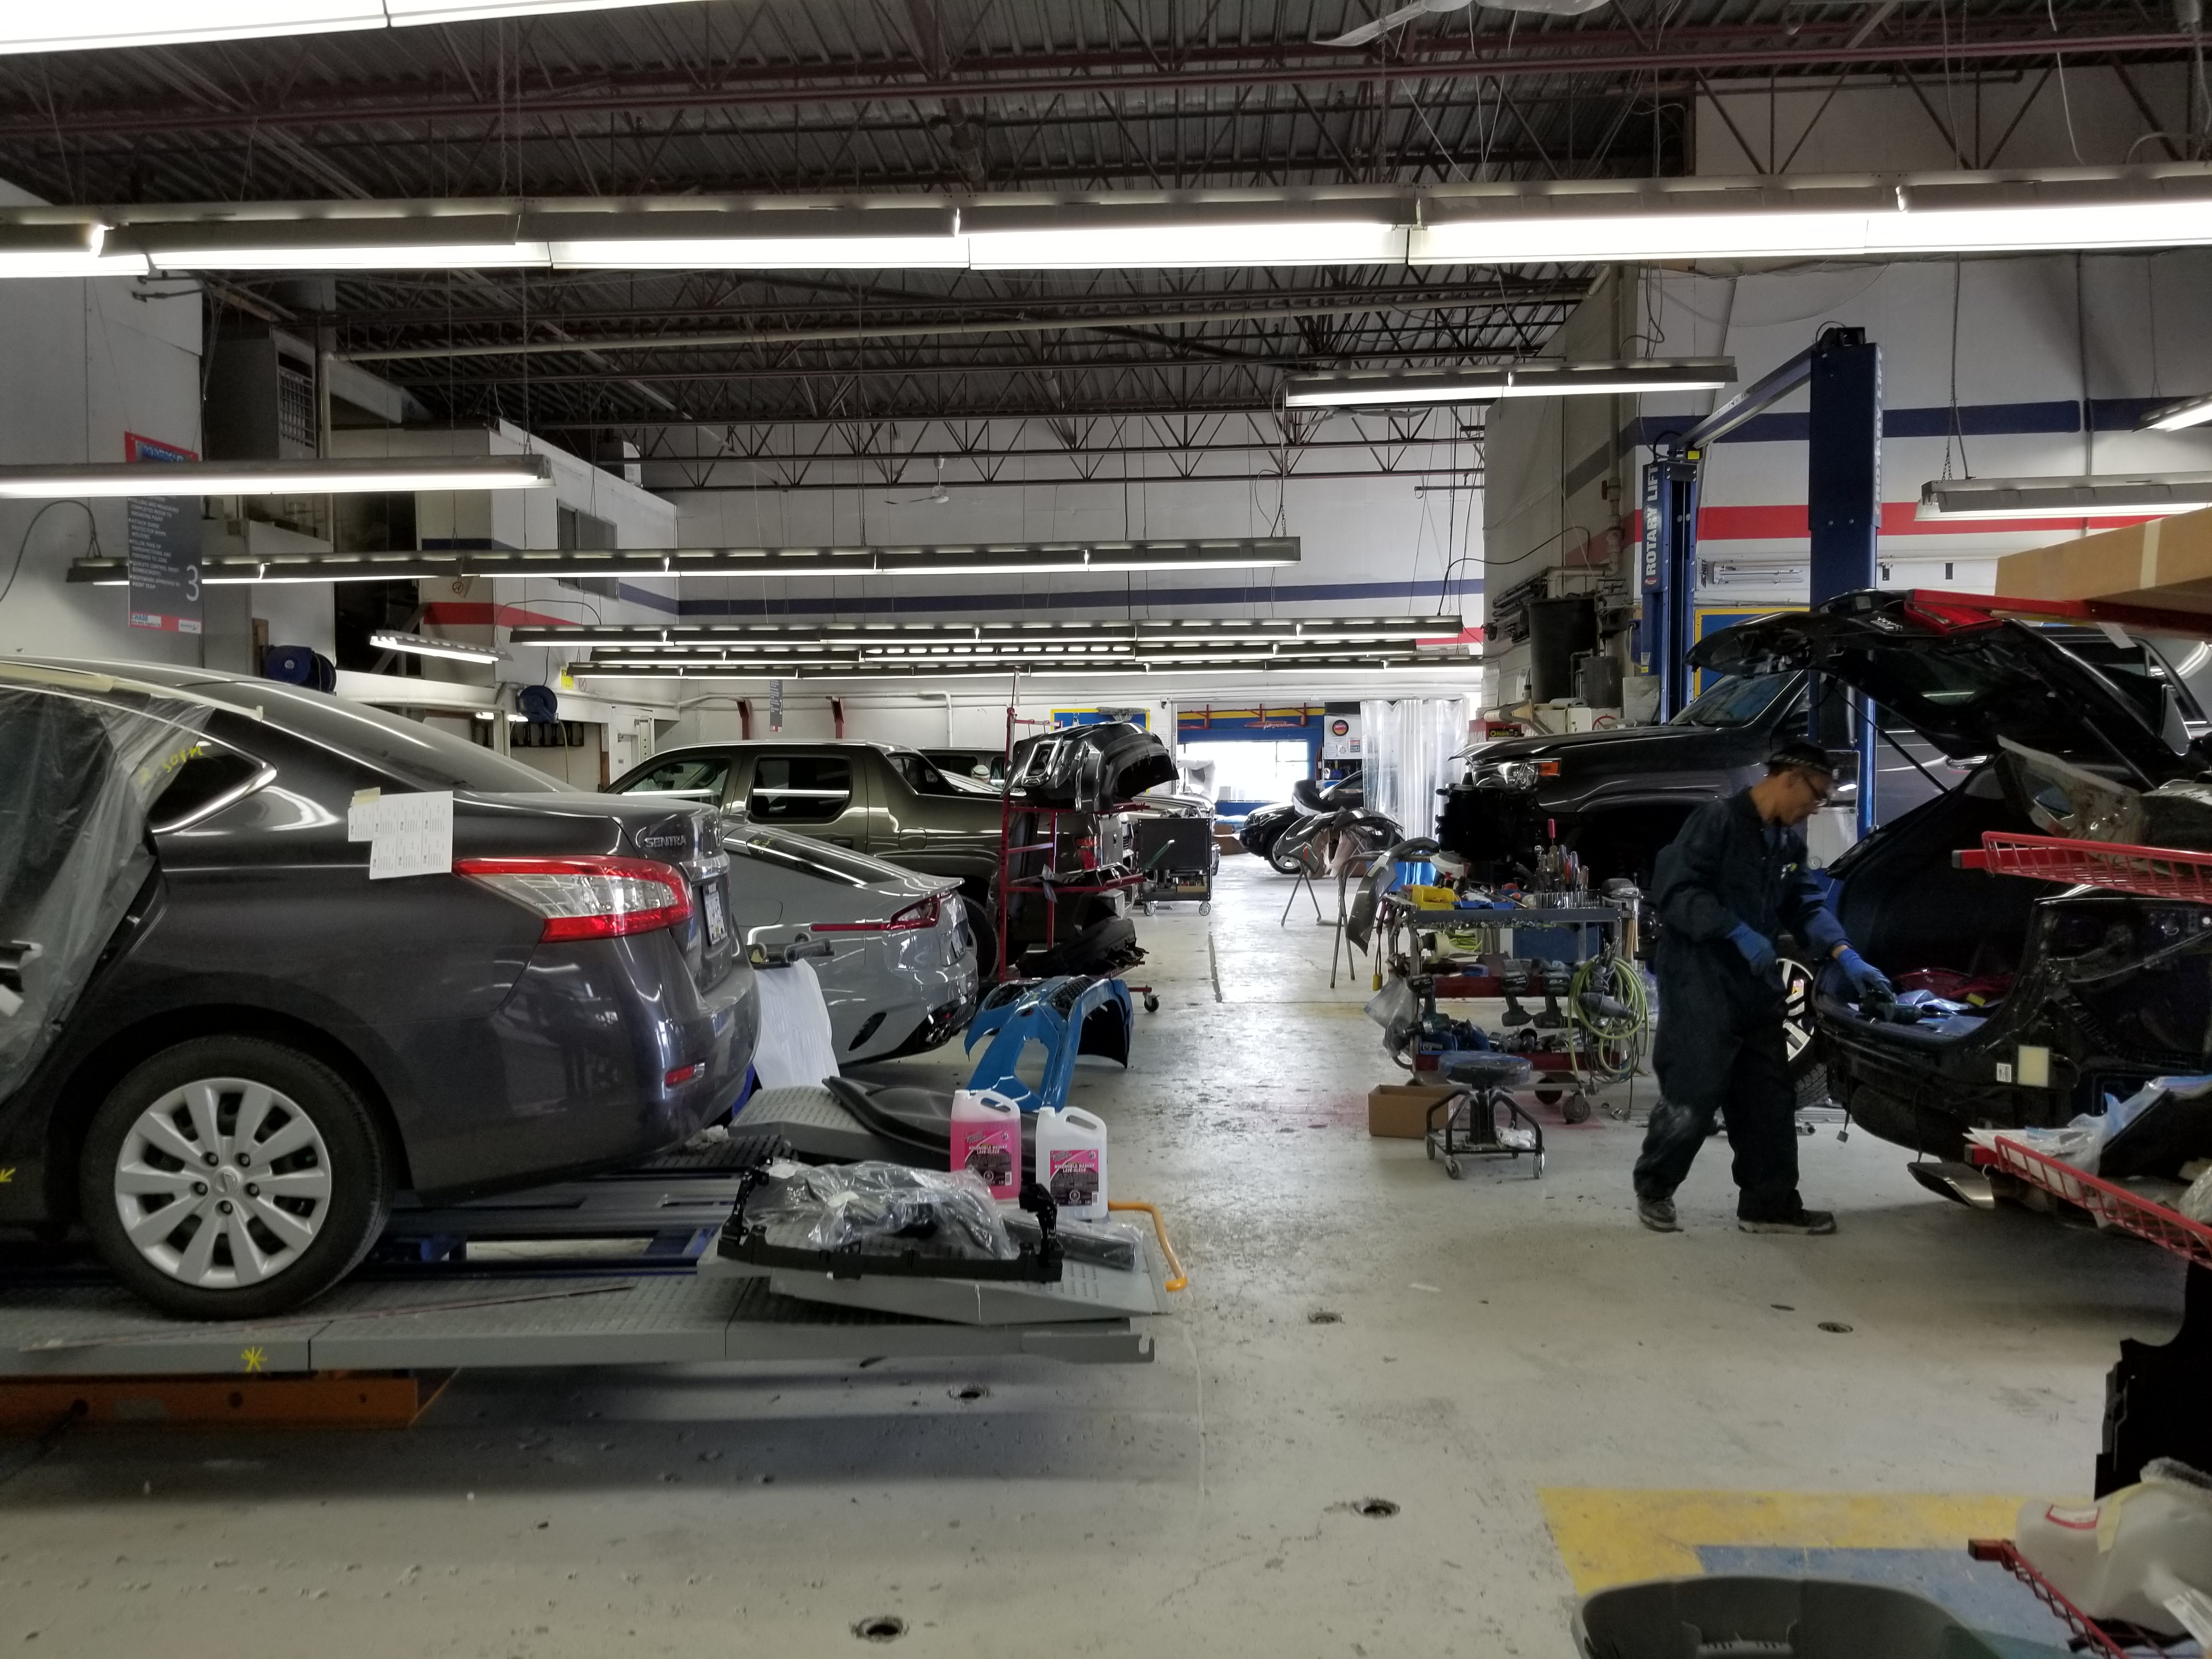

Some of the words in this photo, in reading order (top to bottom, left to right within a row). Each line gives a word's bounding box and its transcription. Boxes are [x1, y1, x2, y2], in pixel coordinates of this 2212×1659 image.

[1647, 466, 1658, 501] LIFT
[1646, 506, 1657, 576] ROTARY
[187, 565, 199, 602] 3
[645, 835, 687, 848] SENTRA
